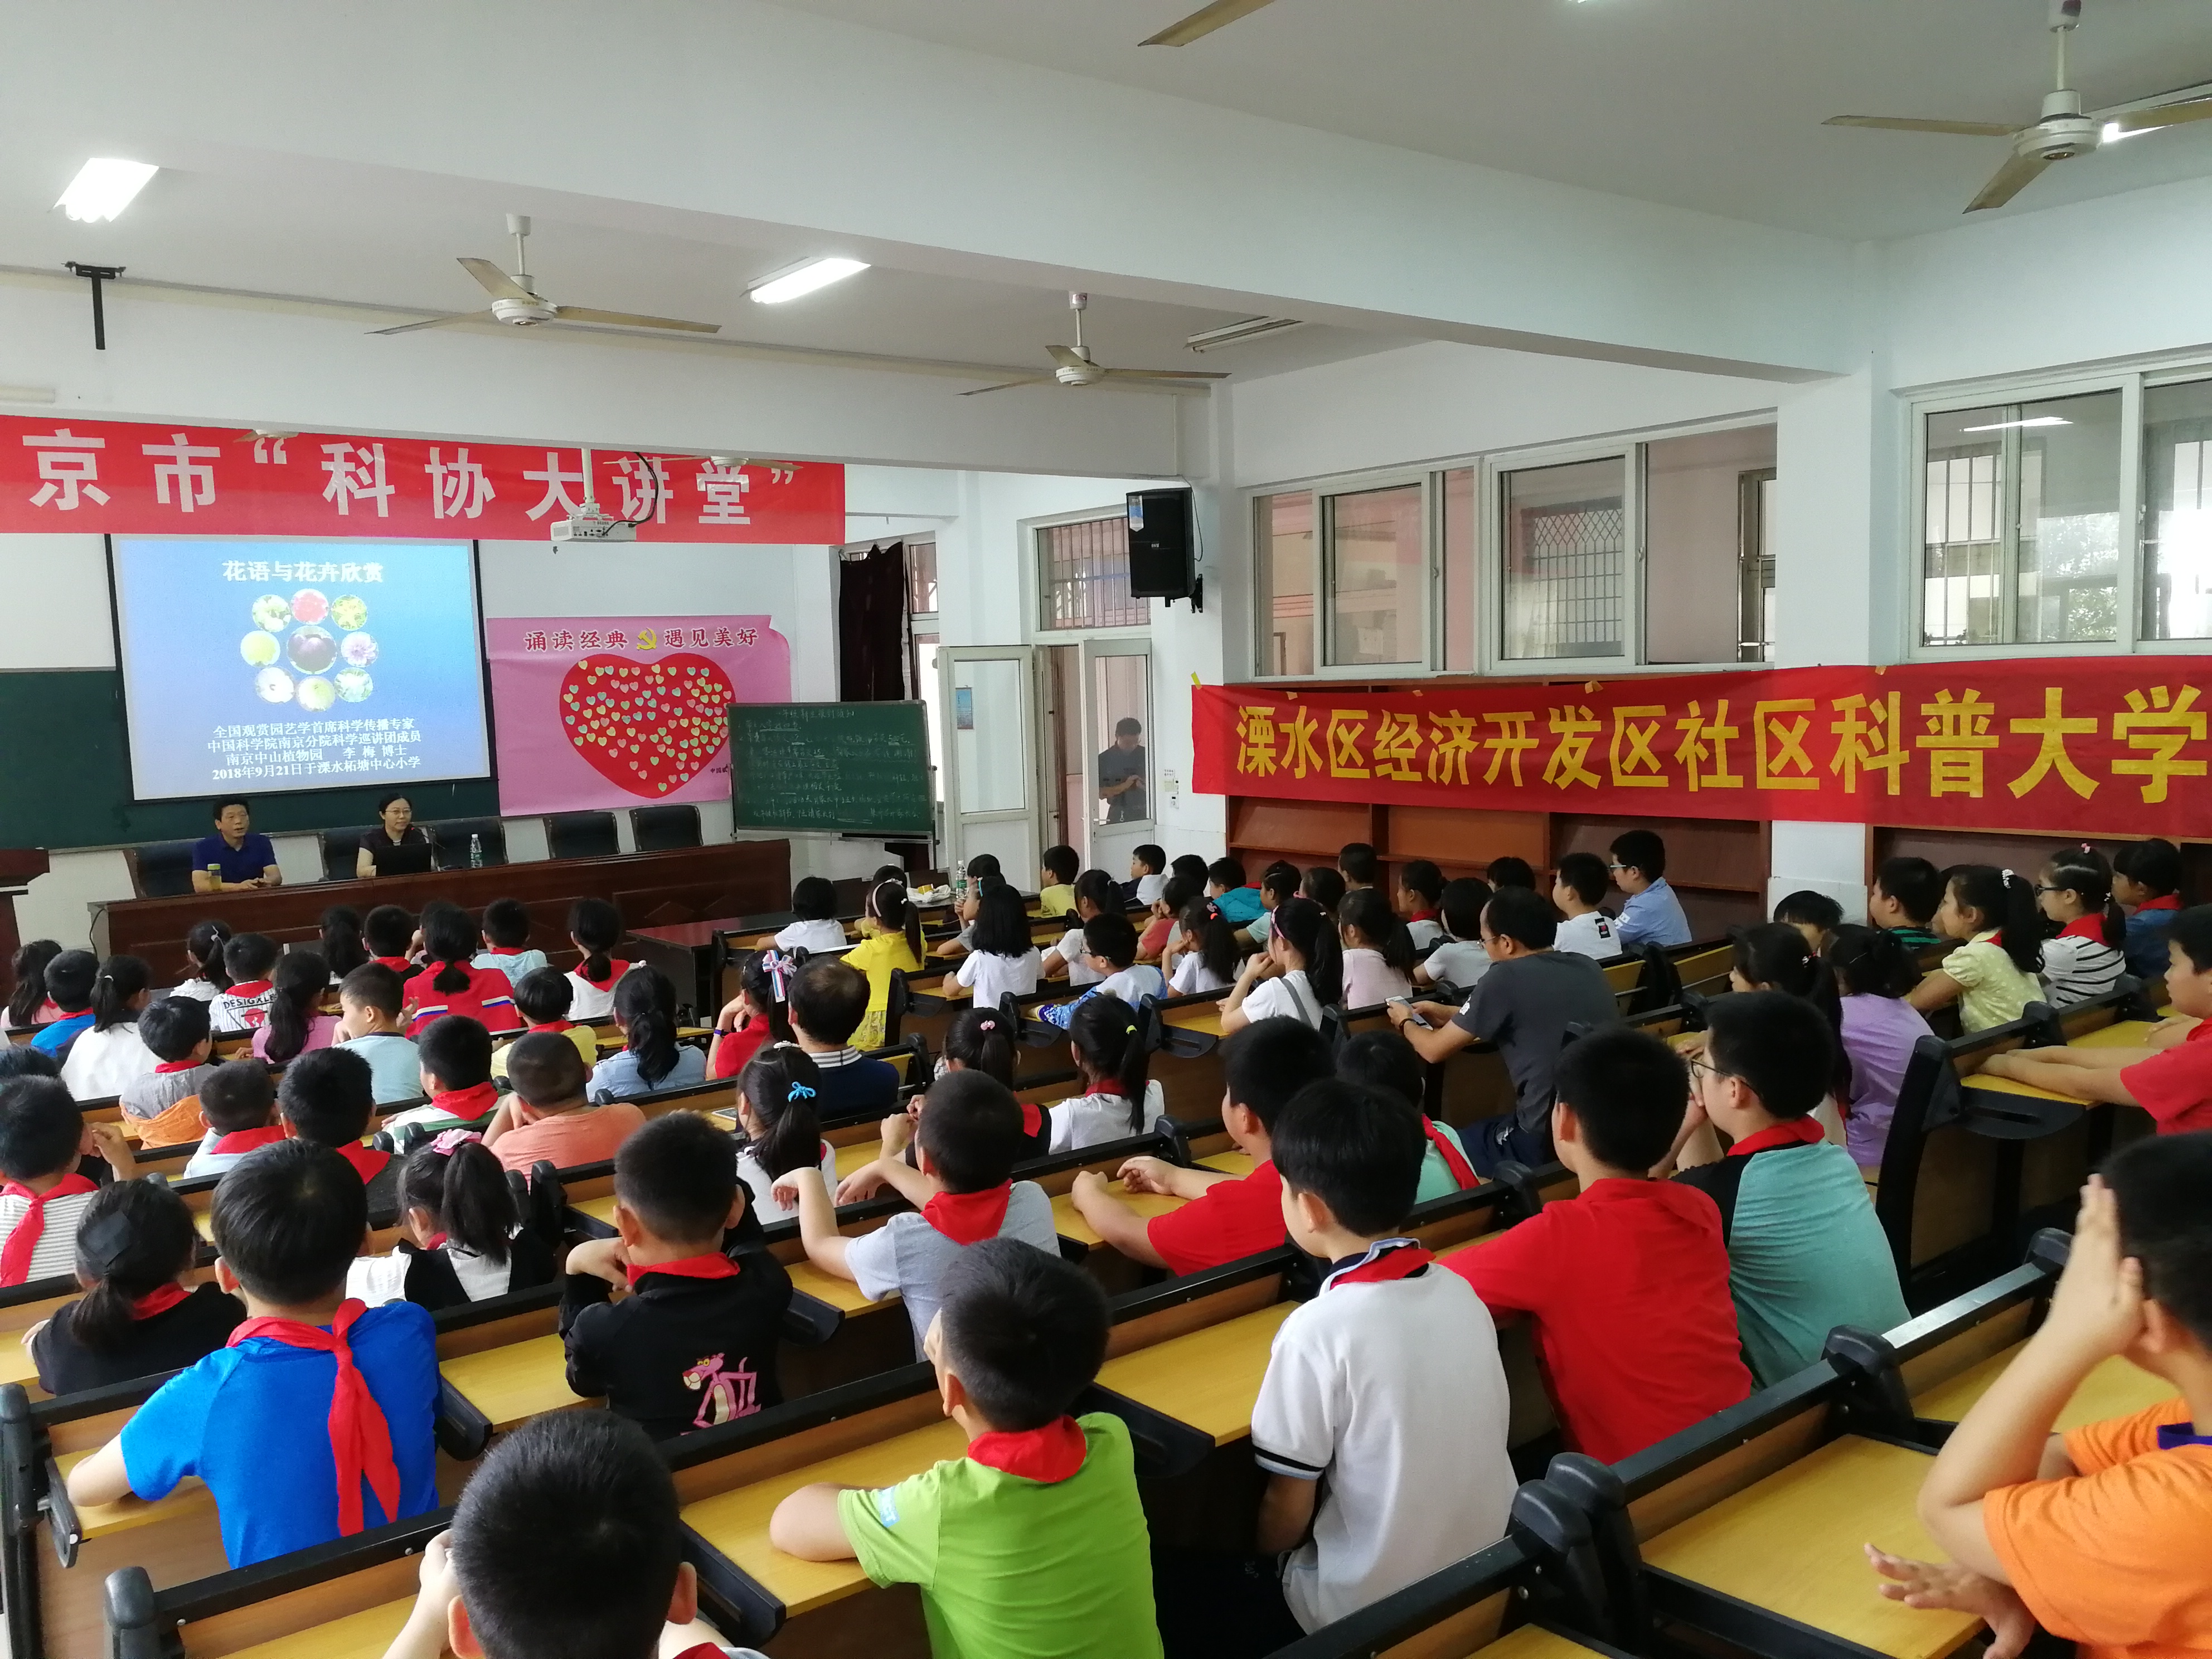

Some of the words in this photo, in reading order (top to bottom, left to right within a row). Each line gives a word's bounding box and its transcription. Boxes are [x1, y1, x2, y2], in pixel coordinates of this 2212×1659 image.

[222, 560, 383, 583] 花语与花卉欣赏
[525, 630, 628, 652] 诵读经典
[664, 627, 759, 649] 遇见美好
[213, 717, 415, 739] 全国观赏园艺学首席科学传播专家
[207, 730, 421, 753] 中国科学院南京分院科学巡讲团成员
[1235, 684, 2208, 803] 溧水区经济开发区社区科普大学
[212, 756, 421, 780] 2018年9月21日于溧水柘塘中心小学
[226, 749, 323, 766] 南京中山植物园
